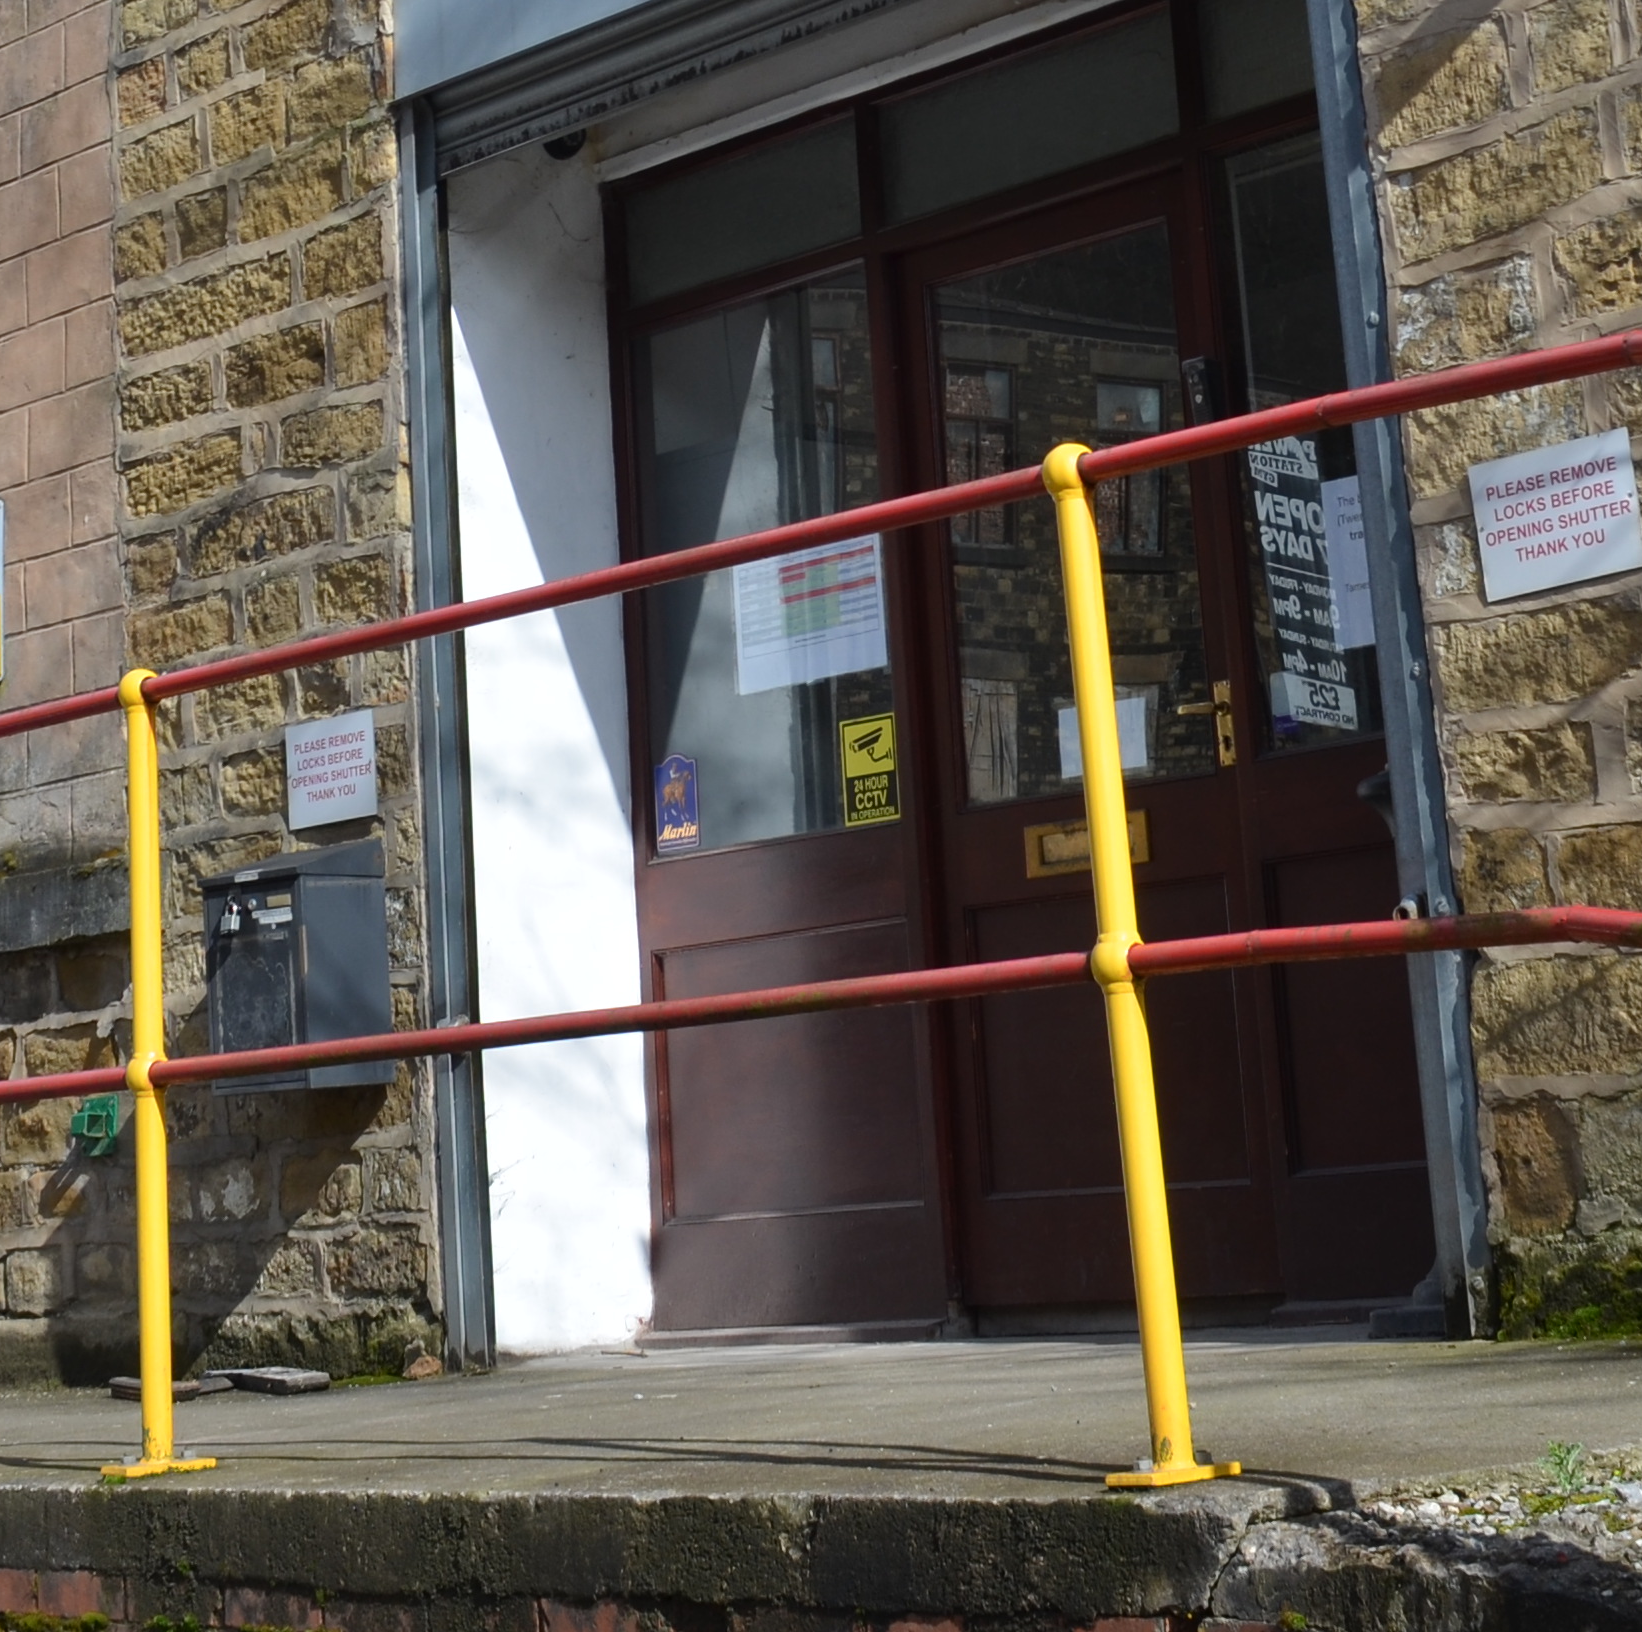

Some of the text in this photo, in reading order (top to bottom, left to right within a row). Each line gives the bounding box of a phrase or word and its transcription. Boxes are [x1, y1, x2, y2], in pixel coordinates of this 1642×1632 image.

[1485, 456, 1617, 502] PLEASE REMOVE
[1337, 496, 1355, 507] The
[1493, 480, 1615, 522] LOCKS BEFORE
[1485, 499, 1632, 547] OPENING SHUTTER
[1515, 529, 1606, 563] THANK YOU
[293, 730, 366, 755] PLEASE REMOVE
[297, 748, 363, 772] LOCKS BEFORE
[291, 763, 372, 789] OPENING SHUTTER
[853, 774, 889, 793] 24 HOUR
[306, 784, 356, 803] THANK YOU
[855, 789, 887, 809] CCTV
[859, 806, 895, 820] OPERATION
[658, 821, 697, 841] Marlin
